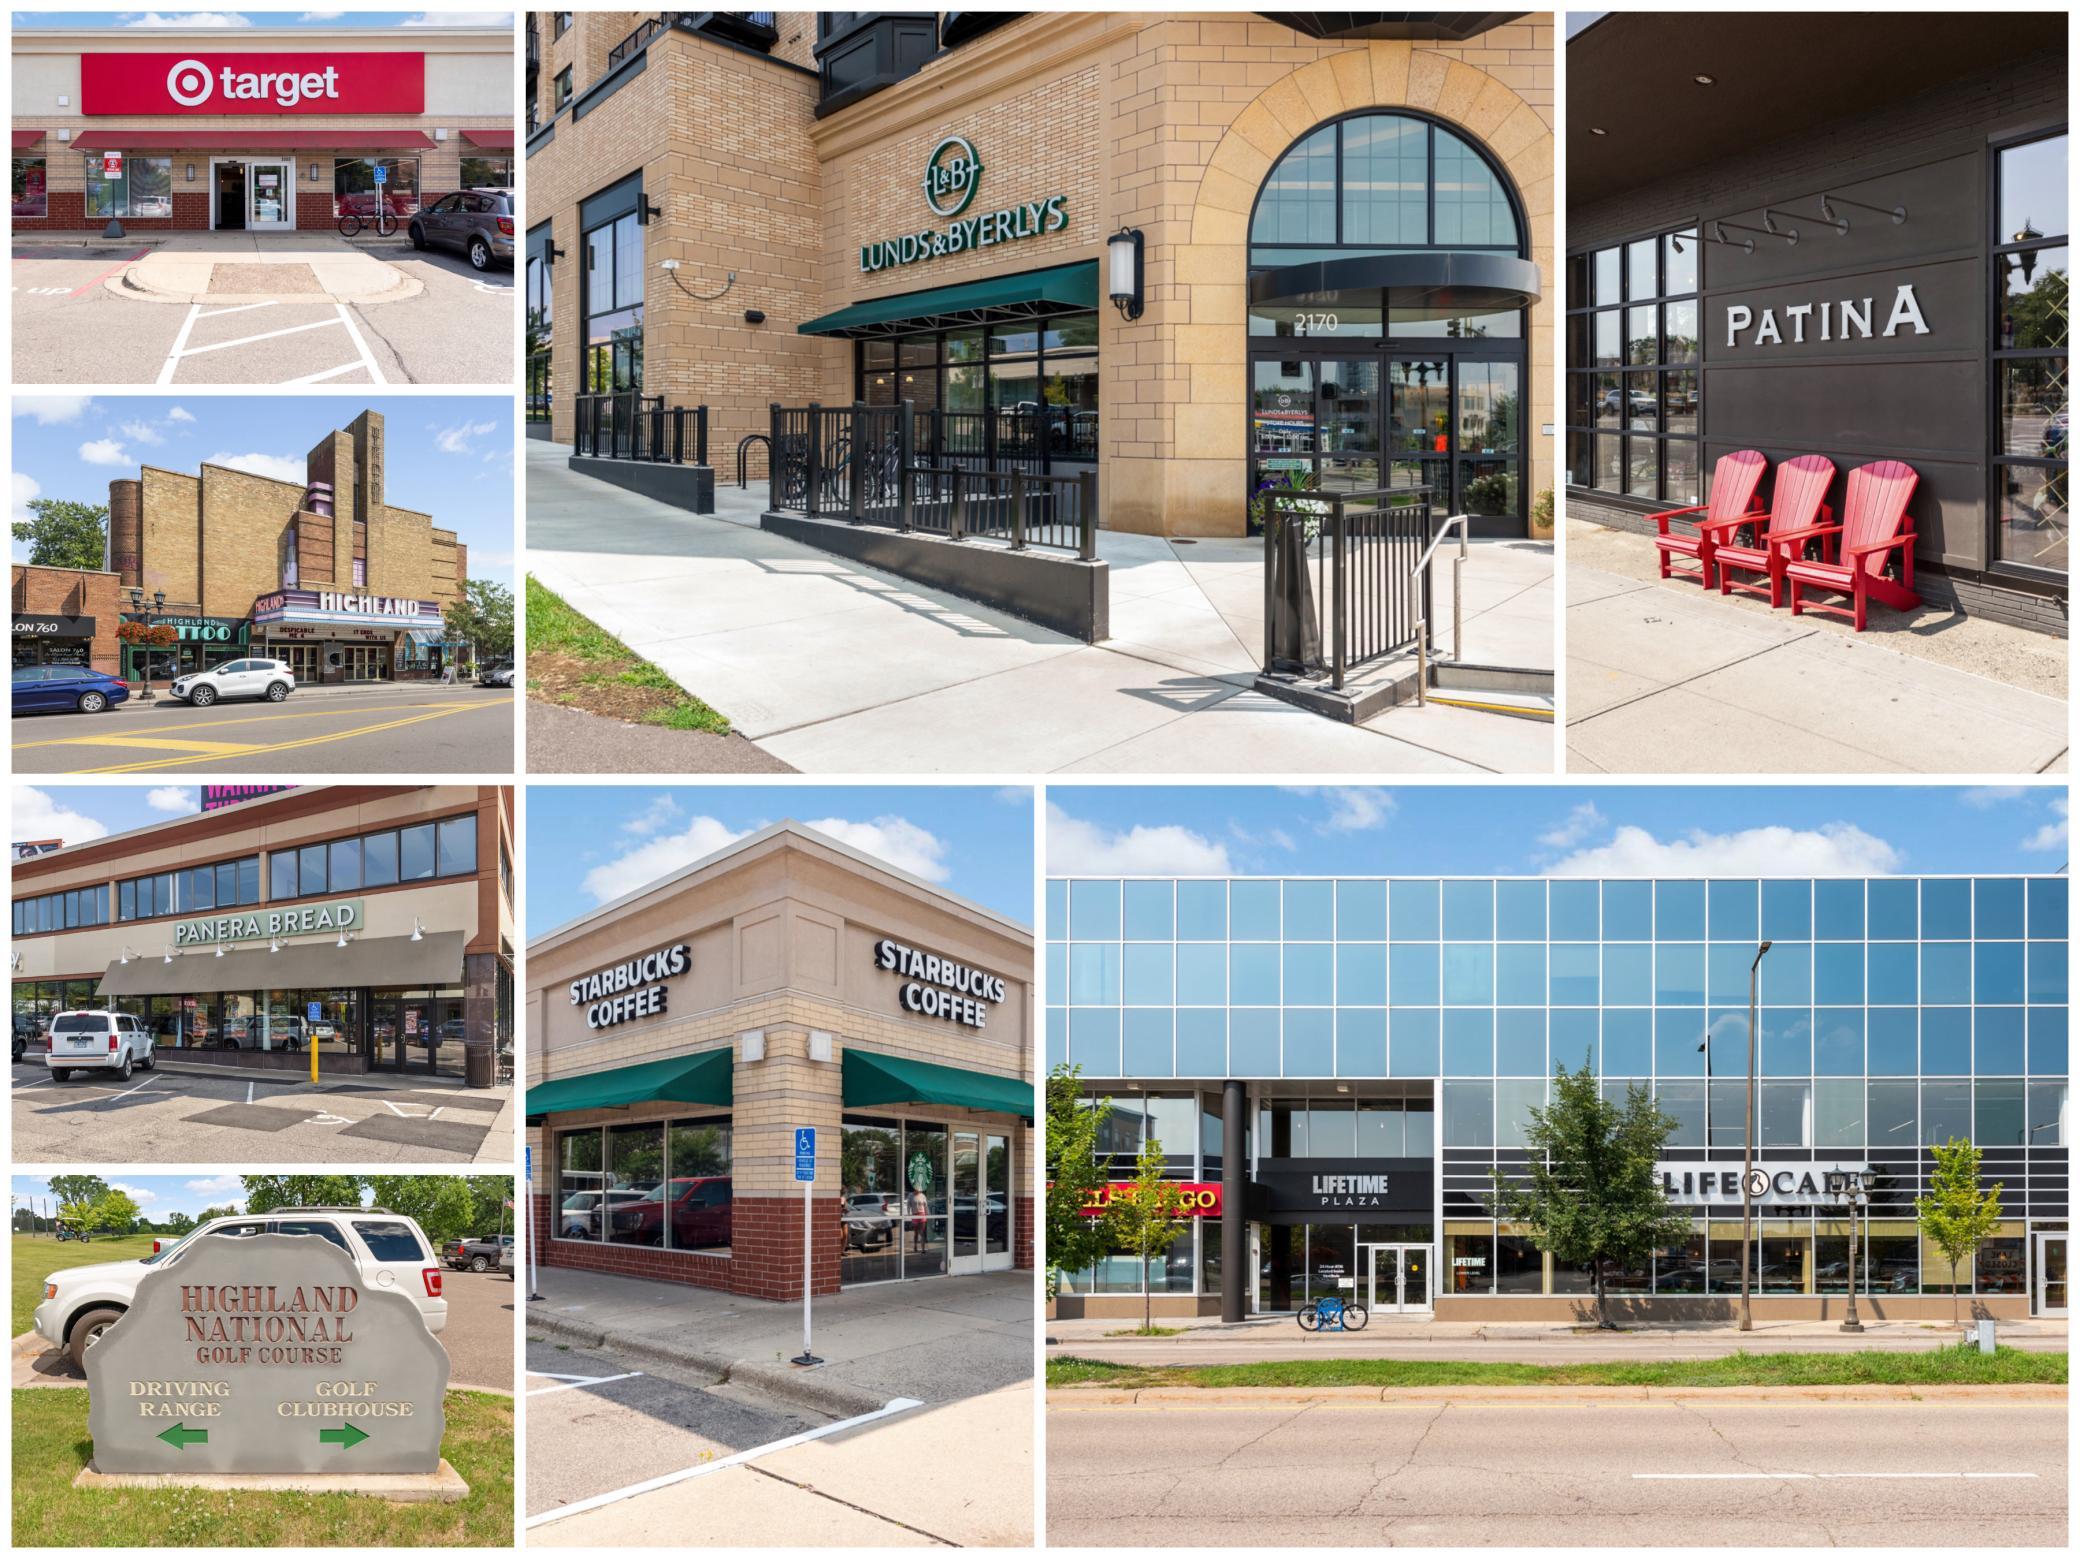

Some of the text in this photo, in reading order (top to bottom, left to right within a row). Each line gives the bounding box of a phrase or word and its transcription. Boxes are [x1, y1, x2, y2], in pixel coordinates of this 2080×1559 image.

[219, 66, 339, 107] target
[931, 157, 967, 196] L&B
[860, 196, 1069, 273] LUNDS&BYERLYS
[1295, 313, 1338, 331] 2170
[255, 597, 284, 613] HIGHLAND
[320, 592, 420, 616] HIGHLAND
[36, 623, 58, 632] 760
[166, 618, 216, 626] HIGHLAND
[176, 905, 355, 943] PANERA BREAD
[570, 944, 688, 1005] STARBUCKS
[879, 939, 1006, 1003] STARBUCKS
[587, 986, 664, 1029] COFFEE
[903, 982, 987, 1028] COFFEE
[1312, 1175, 1389, 1194] LIFETIME
[1663, 1172, 1739, 1194] LIFE
[1321, 1196, 1380, 1206] PLAZA
[1452, 1257, 1486, 1266] LIFETIME
[180, 1285, 359, 1313] HIGHLAND
[184, 1316, 353, 1343] NATIONAL
[196, 1347, 342, 1364] GOLF COURSE
[128, 1381, 232, 1397] DRIVING
[315, 1381, 379, 1397] GOLF
[138, 1402, 222, 1417] RANGE
[277, 1402, 415, 1417] CLUBHOUSE
